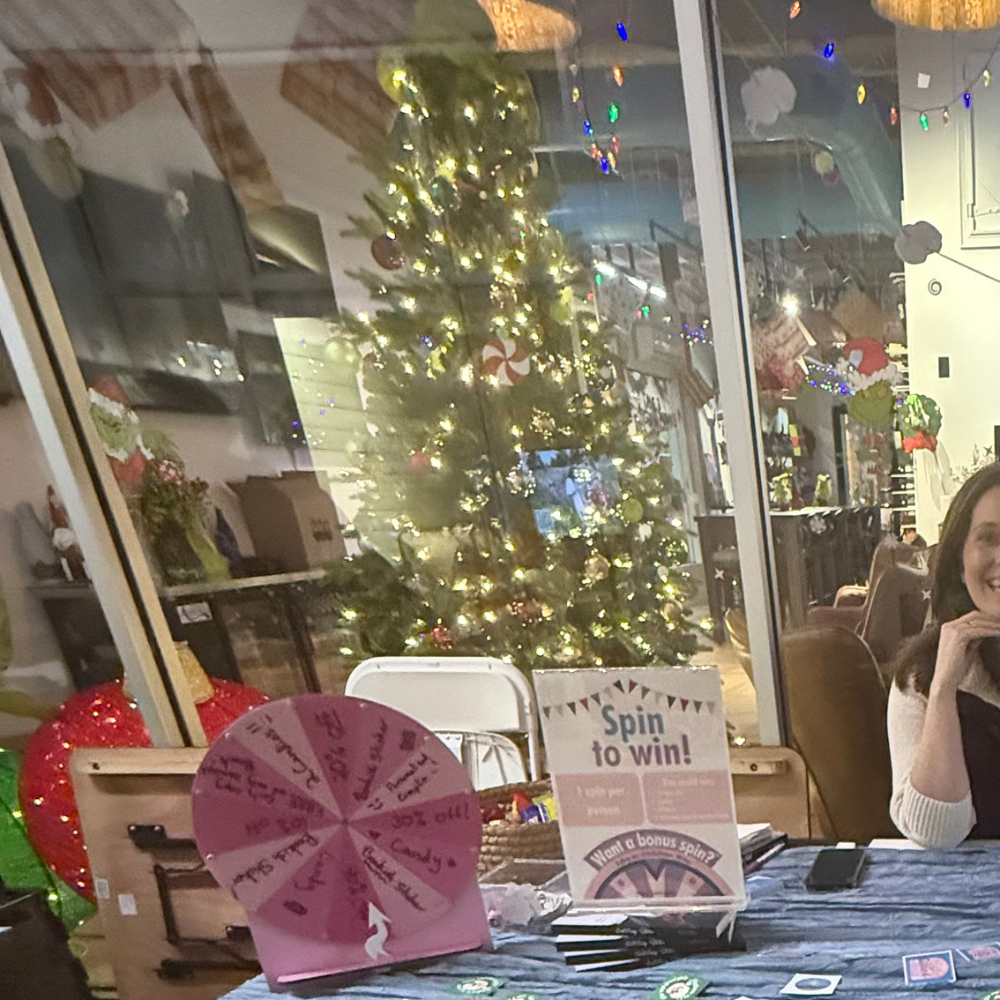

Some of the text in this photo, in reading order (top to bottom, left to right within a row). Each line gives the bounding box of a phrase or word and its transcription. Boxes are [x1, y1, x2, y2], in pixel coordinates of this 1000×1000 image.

[602, 704, 665, 743] Spin
[592, 734, 692, 767] to win!
[590, 840, 625, 867] Want
[626, 840, 635, 849] a
[636, 831, 677, 849] bonus
[679, 841, 716, 864] spin?
